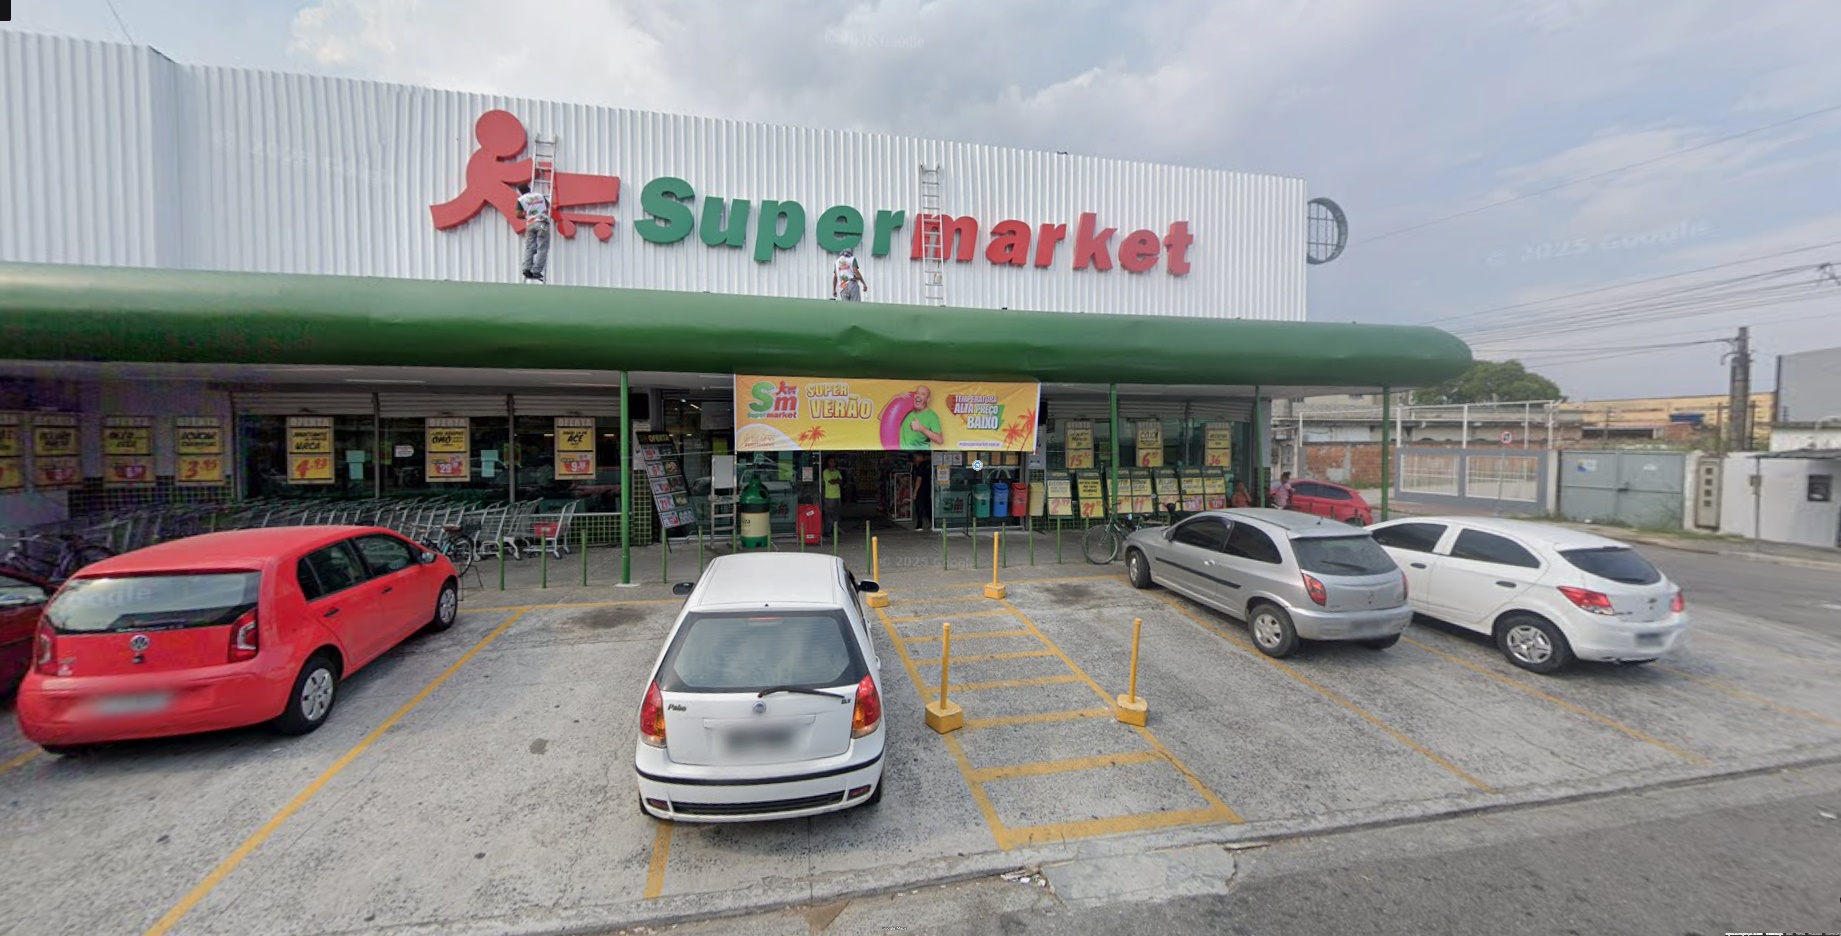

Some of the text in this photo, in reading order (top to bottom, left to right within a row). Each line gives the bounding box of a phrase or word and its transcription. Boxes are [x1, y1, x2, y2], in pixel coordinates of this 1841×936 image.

[633, 175, 1195, 279] Supermarket
[806, 384, 849, 398] SUPER
[955, 395, 998, 404] TEMPERATURA
[809, 395, 874, 419] VERÃO
[953, 403, 999, 415] ALTA PREÇO
[967, 416, 999, 430] BAIXO
[432, 436, 451, 444] OMO
[567, 434, 584, 442] ACE
[648, 433, 670, 442] OFERTA
[667, 703, 687, 712] Palio
